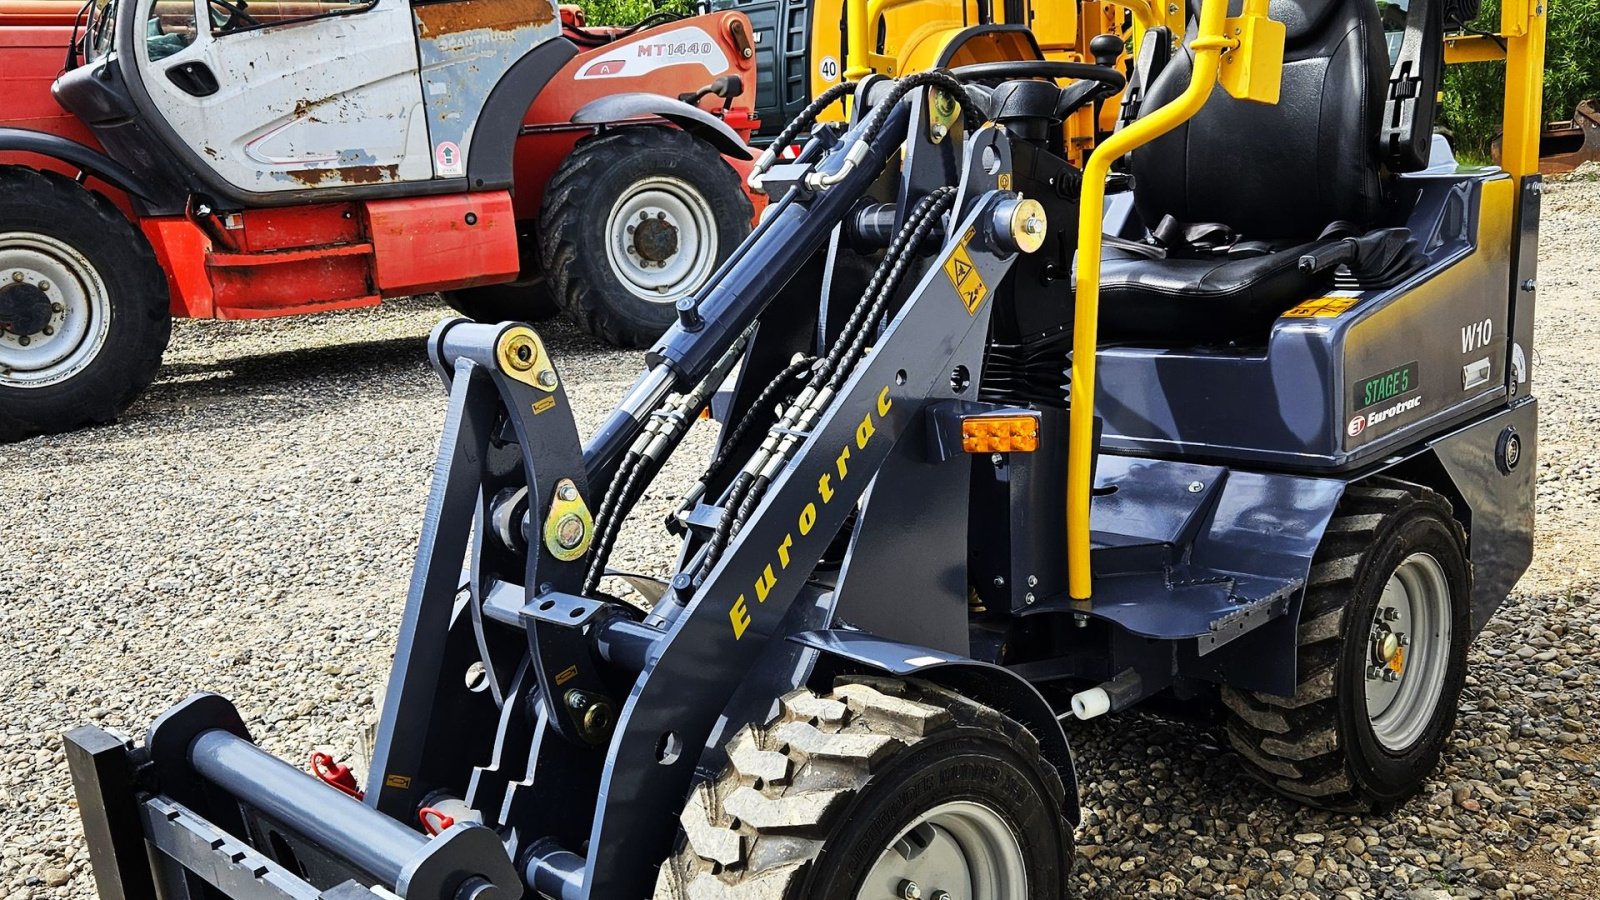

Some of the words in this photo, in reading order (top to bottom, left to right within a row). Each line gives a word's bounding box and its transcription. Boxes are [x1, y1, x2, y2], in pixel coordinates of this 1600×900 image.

[637, 42, 712, 57] MT1440
[822, 61, 836, 77] 40
[1462, 318, 1492, 354] W10
[1365, 371, 1400, 405] STAGE
[1402, 369, 1409, 391] 5
[1367, 396, 1422, 428] Eurotrac
[728, 385, 892, 640] Eurotrac
